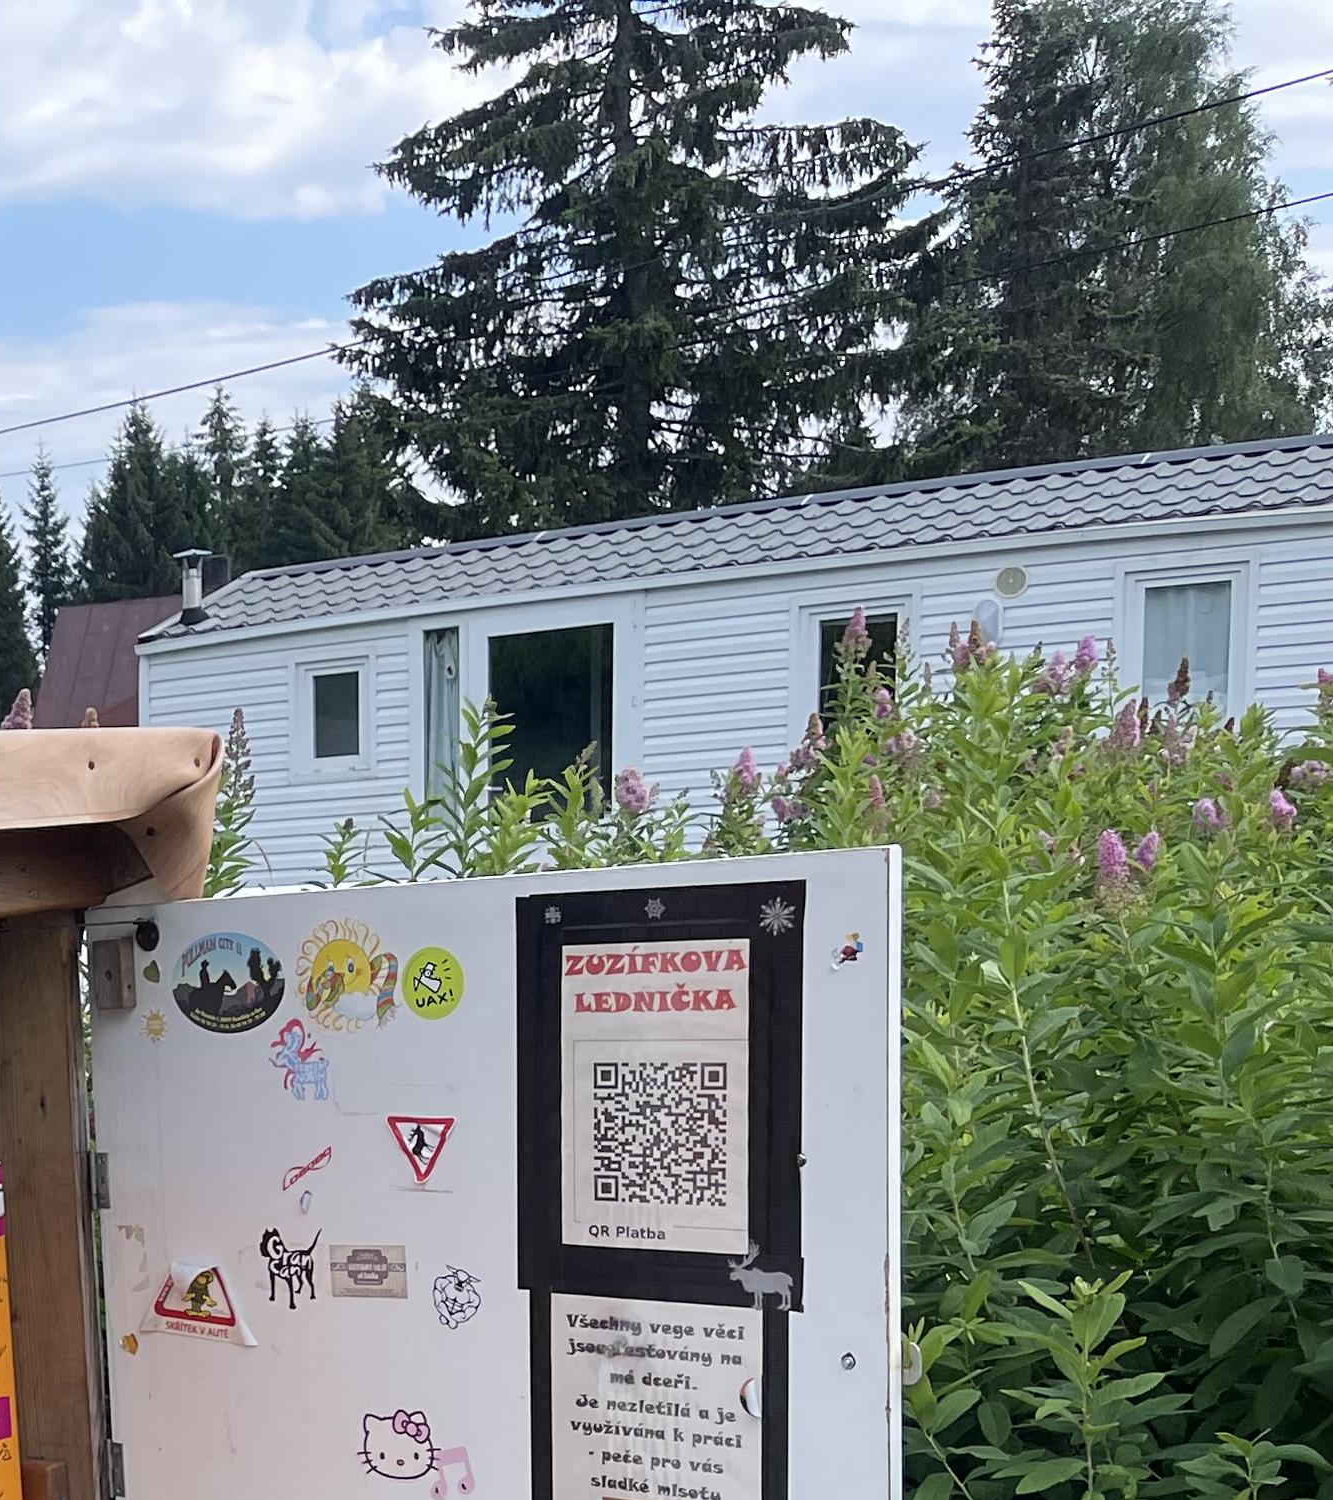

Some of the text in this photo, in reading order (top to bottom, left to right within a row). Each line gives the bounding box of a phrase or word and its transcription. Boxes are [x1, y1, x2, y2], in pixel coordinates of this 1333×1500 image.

[181, 937, 216, 977] PULLMAN
[218, 938, 234, 951] CITY
[564, 945, 748, 977] ZUZÍFKOVA
[415, 988, 455, 1008] UAX!
[574, 983, 738, 1014] LEDNIČKA
[588, 1225, 666, 1241] QR Platba
[267, 1235, 312, 1270] Gran
[165, 1320, 199, 1334] SKŘÍTEK
[199, 1326, 206, 1335] V
[567, 1313, 745, 1341] Všechny vege věci
[720, 1354, 743, 1366] na
[609, 1370, 635, 1385] mé
[575, 1394, 737, 1425] Je nezletilá a je
[570, 1419, 743, 1449] využívána k práci
[601, 1448, 724, 1475] peče pro vás
[591, 1474, 650, 1495] sladké
